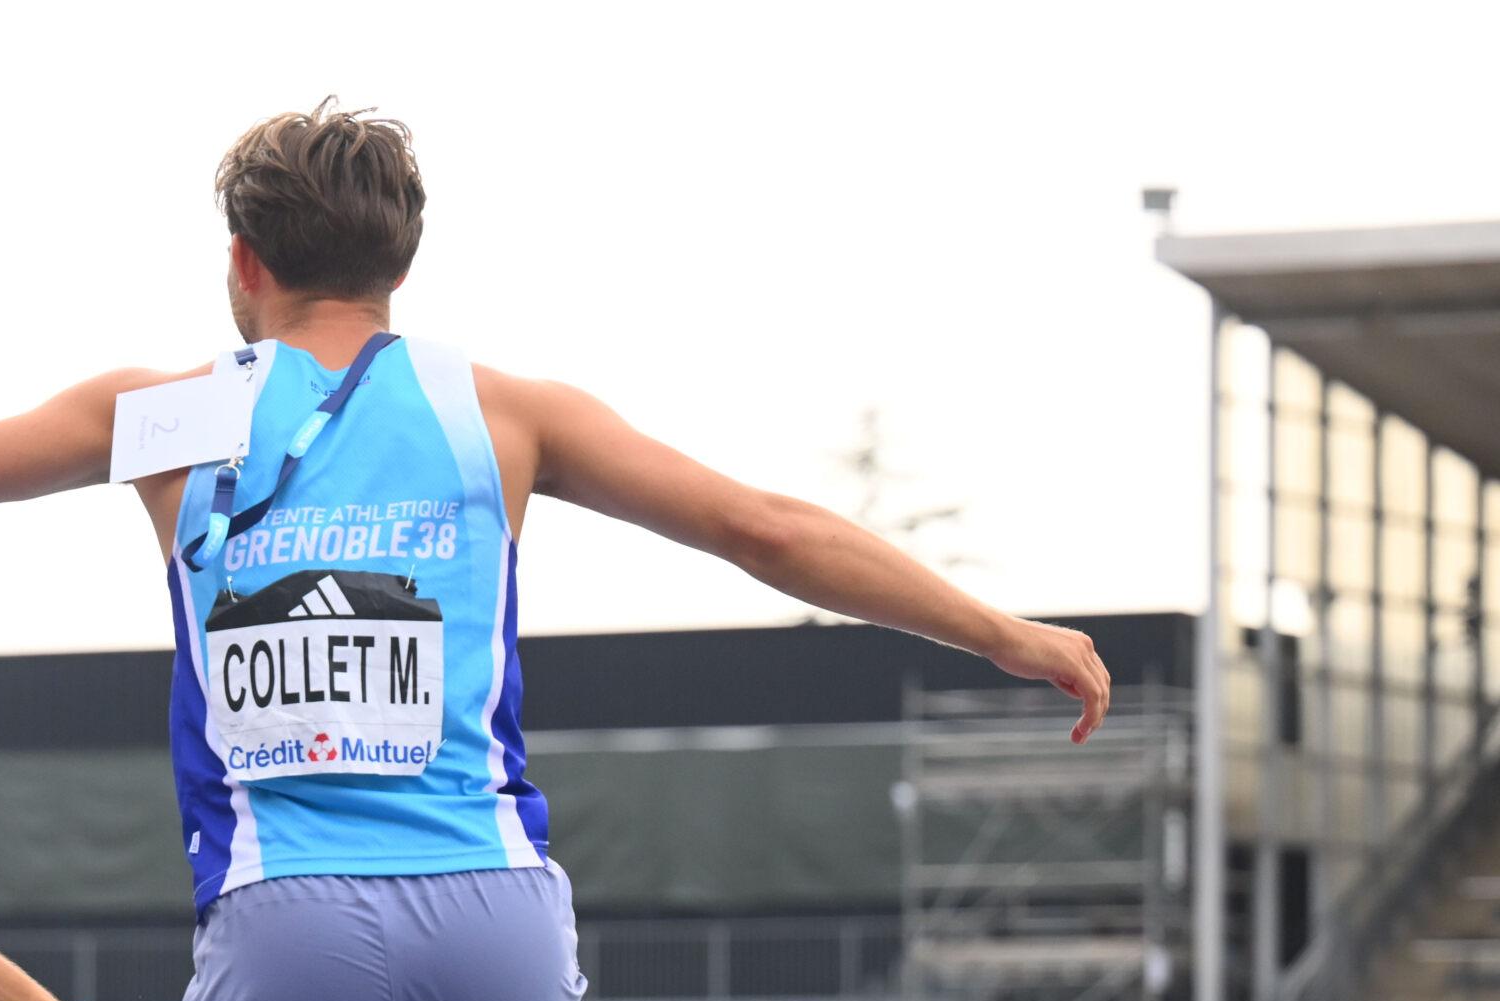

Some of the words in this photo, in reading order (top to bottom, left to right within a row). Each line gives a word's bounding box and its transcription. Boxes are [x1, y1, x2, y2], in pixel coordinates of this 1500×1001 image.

[224, 520, 413, 572] GRENOBLE
[223, 635, 375, 713] COLLET
[390, 636, 430, 705] M.
[228, 738, 304, 770] Crédit
[341, 737, 432, 765] Mutuel
